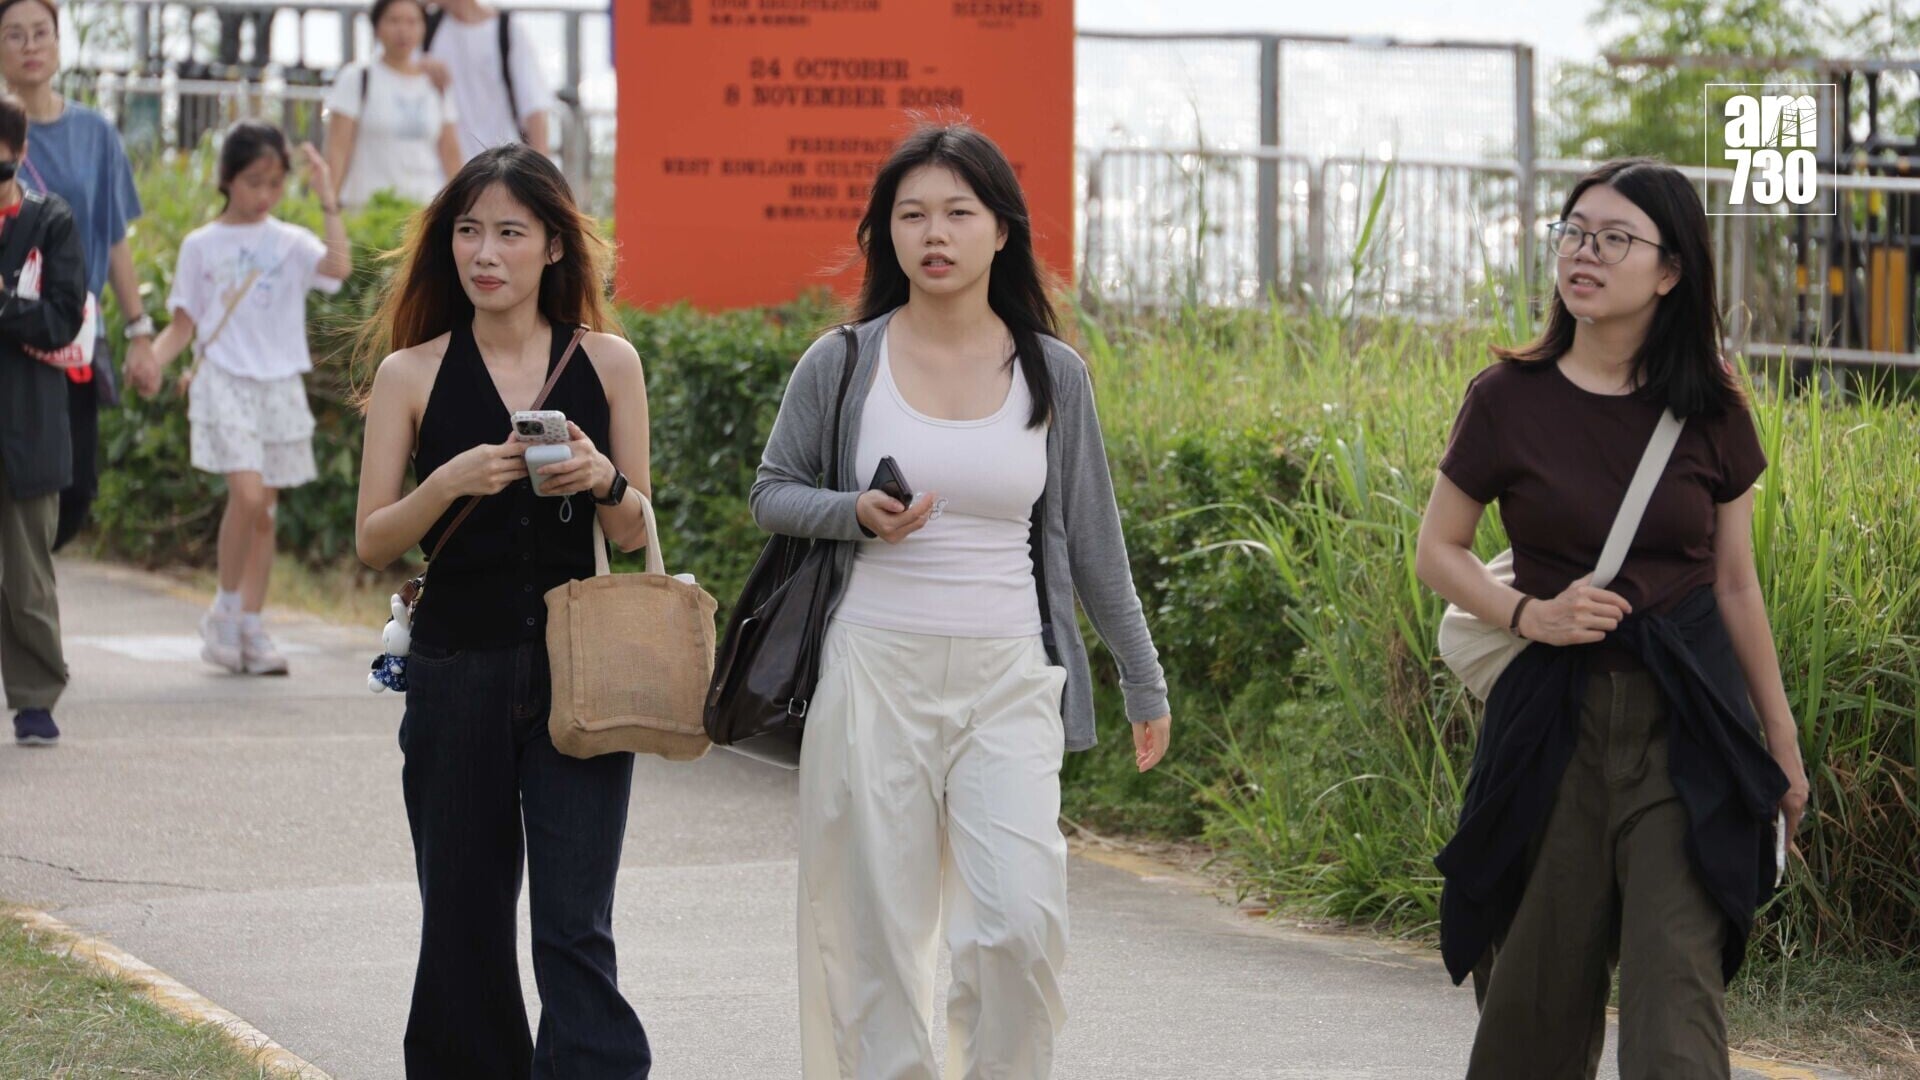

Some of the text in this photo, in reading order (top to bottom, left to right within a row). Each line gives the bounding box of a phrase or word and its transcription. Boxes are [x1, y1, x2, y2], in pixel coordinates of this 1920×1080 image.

[751, 58, 780, 79] 24
[794, 58, 909, 80] OCTOBER
[753, 85, 885, 107] NOVEMBER
[664, 157, 710, 175] WEST
